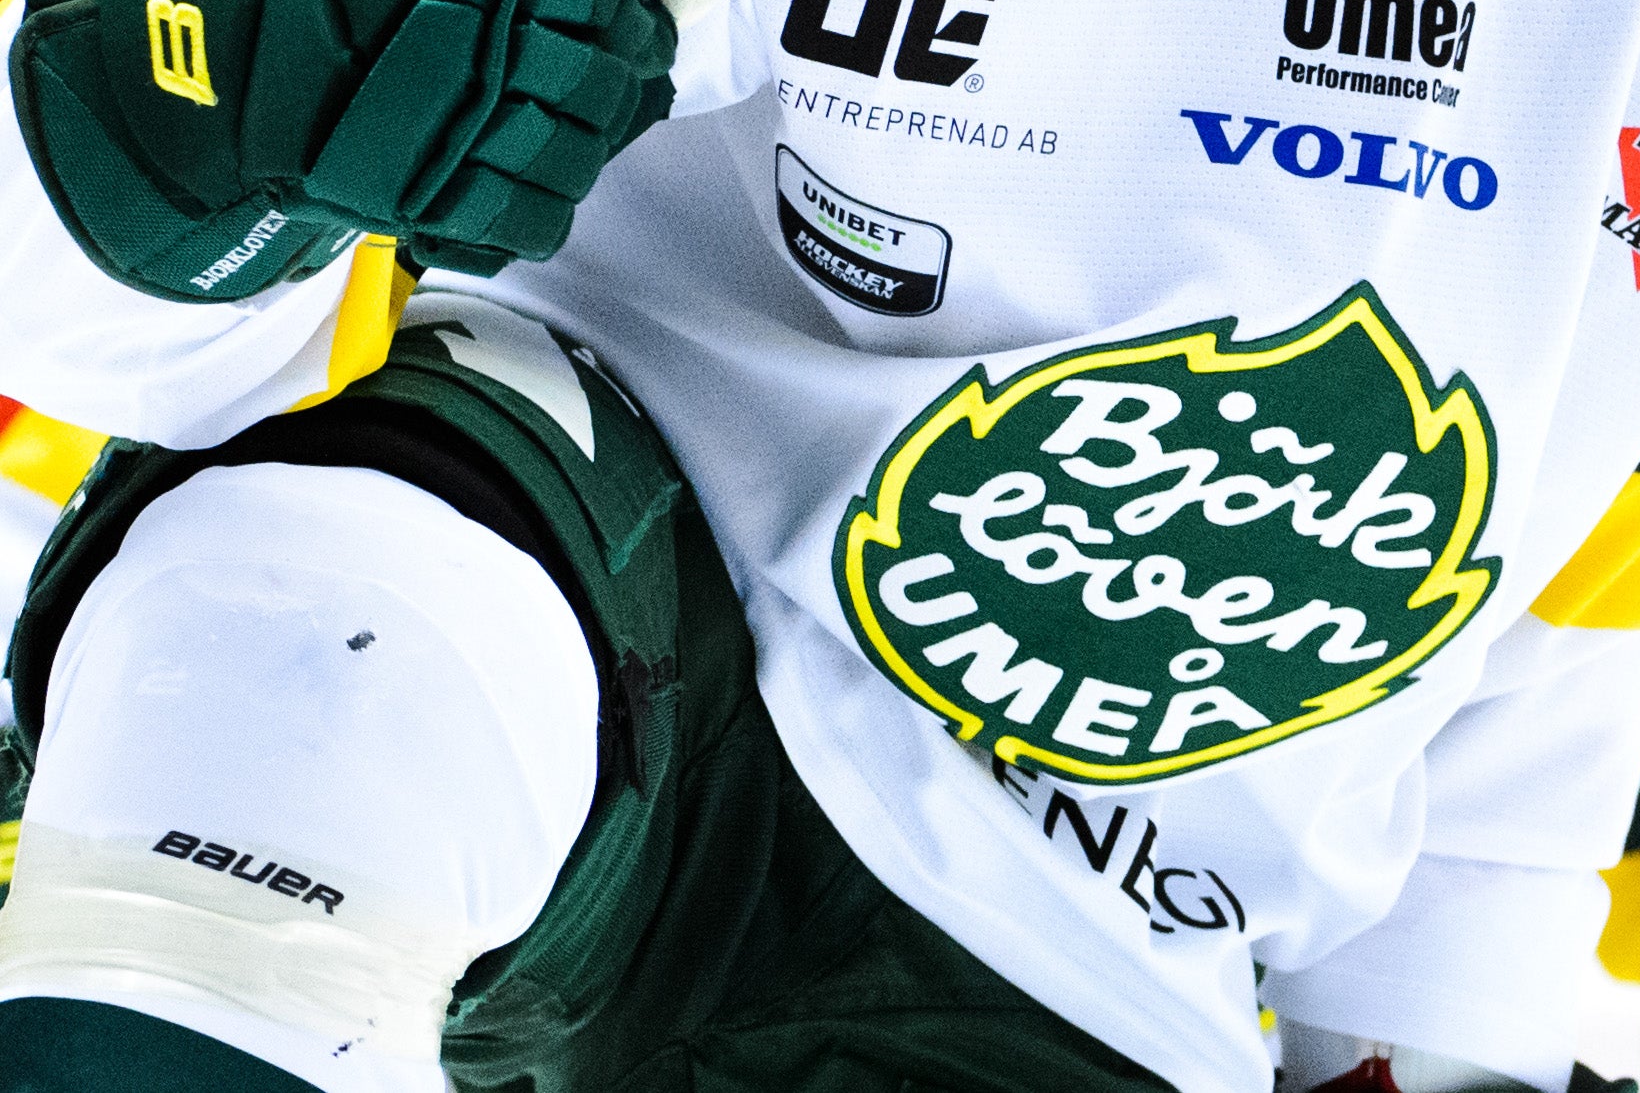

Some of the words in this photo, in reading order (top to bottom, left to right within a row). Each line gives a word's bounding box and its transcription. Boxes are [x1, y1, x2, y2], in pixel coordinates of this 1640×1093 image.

[1276, 55, 1428, 101] Performance
[778, 79, 1009, 150] ENTREPRENAD
[1017, 128, 1058, 155] AB
[1180, 109, 1499, 211] VOLVO
[802, 180, 907, 247] UNIBET
[794, 229, 905, 291] HOCKEY
[878, 551, 1273, 756] UMEÅ
